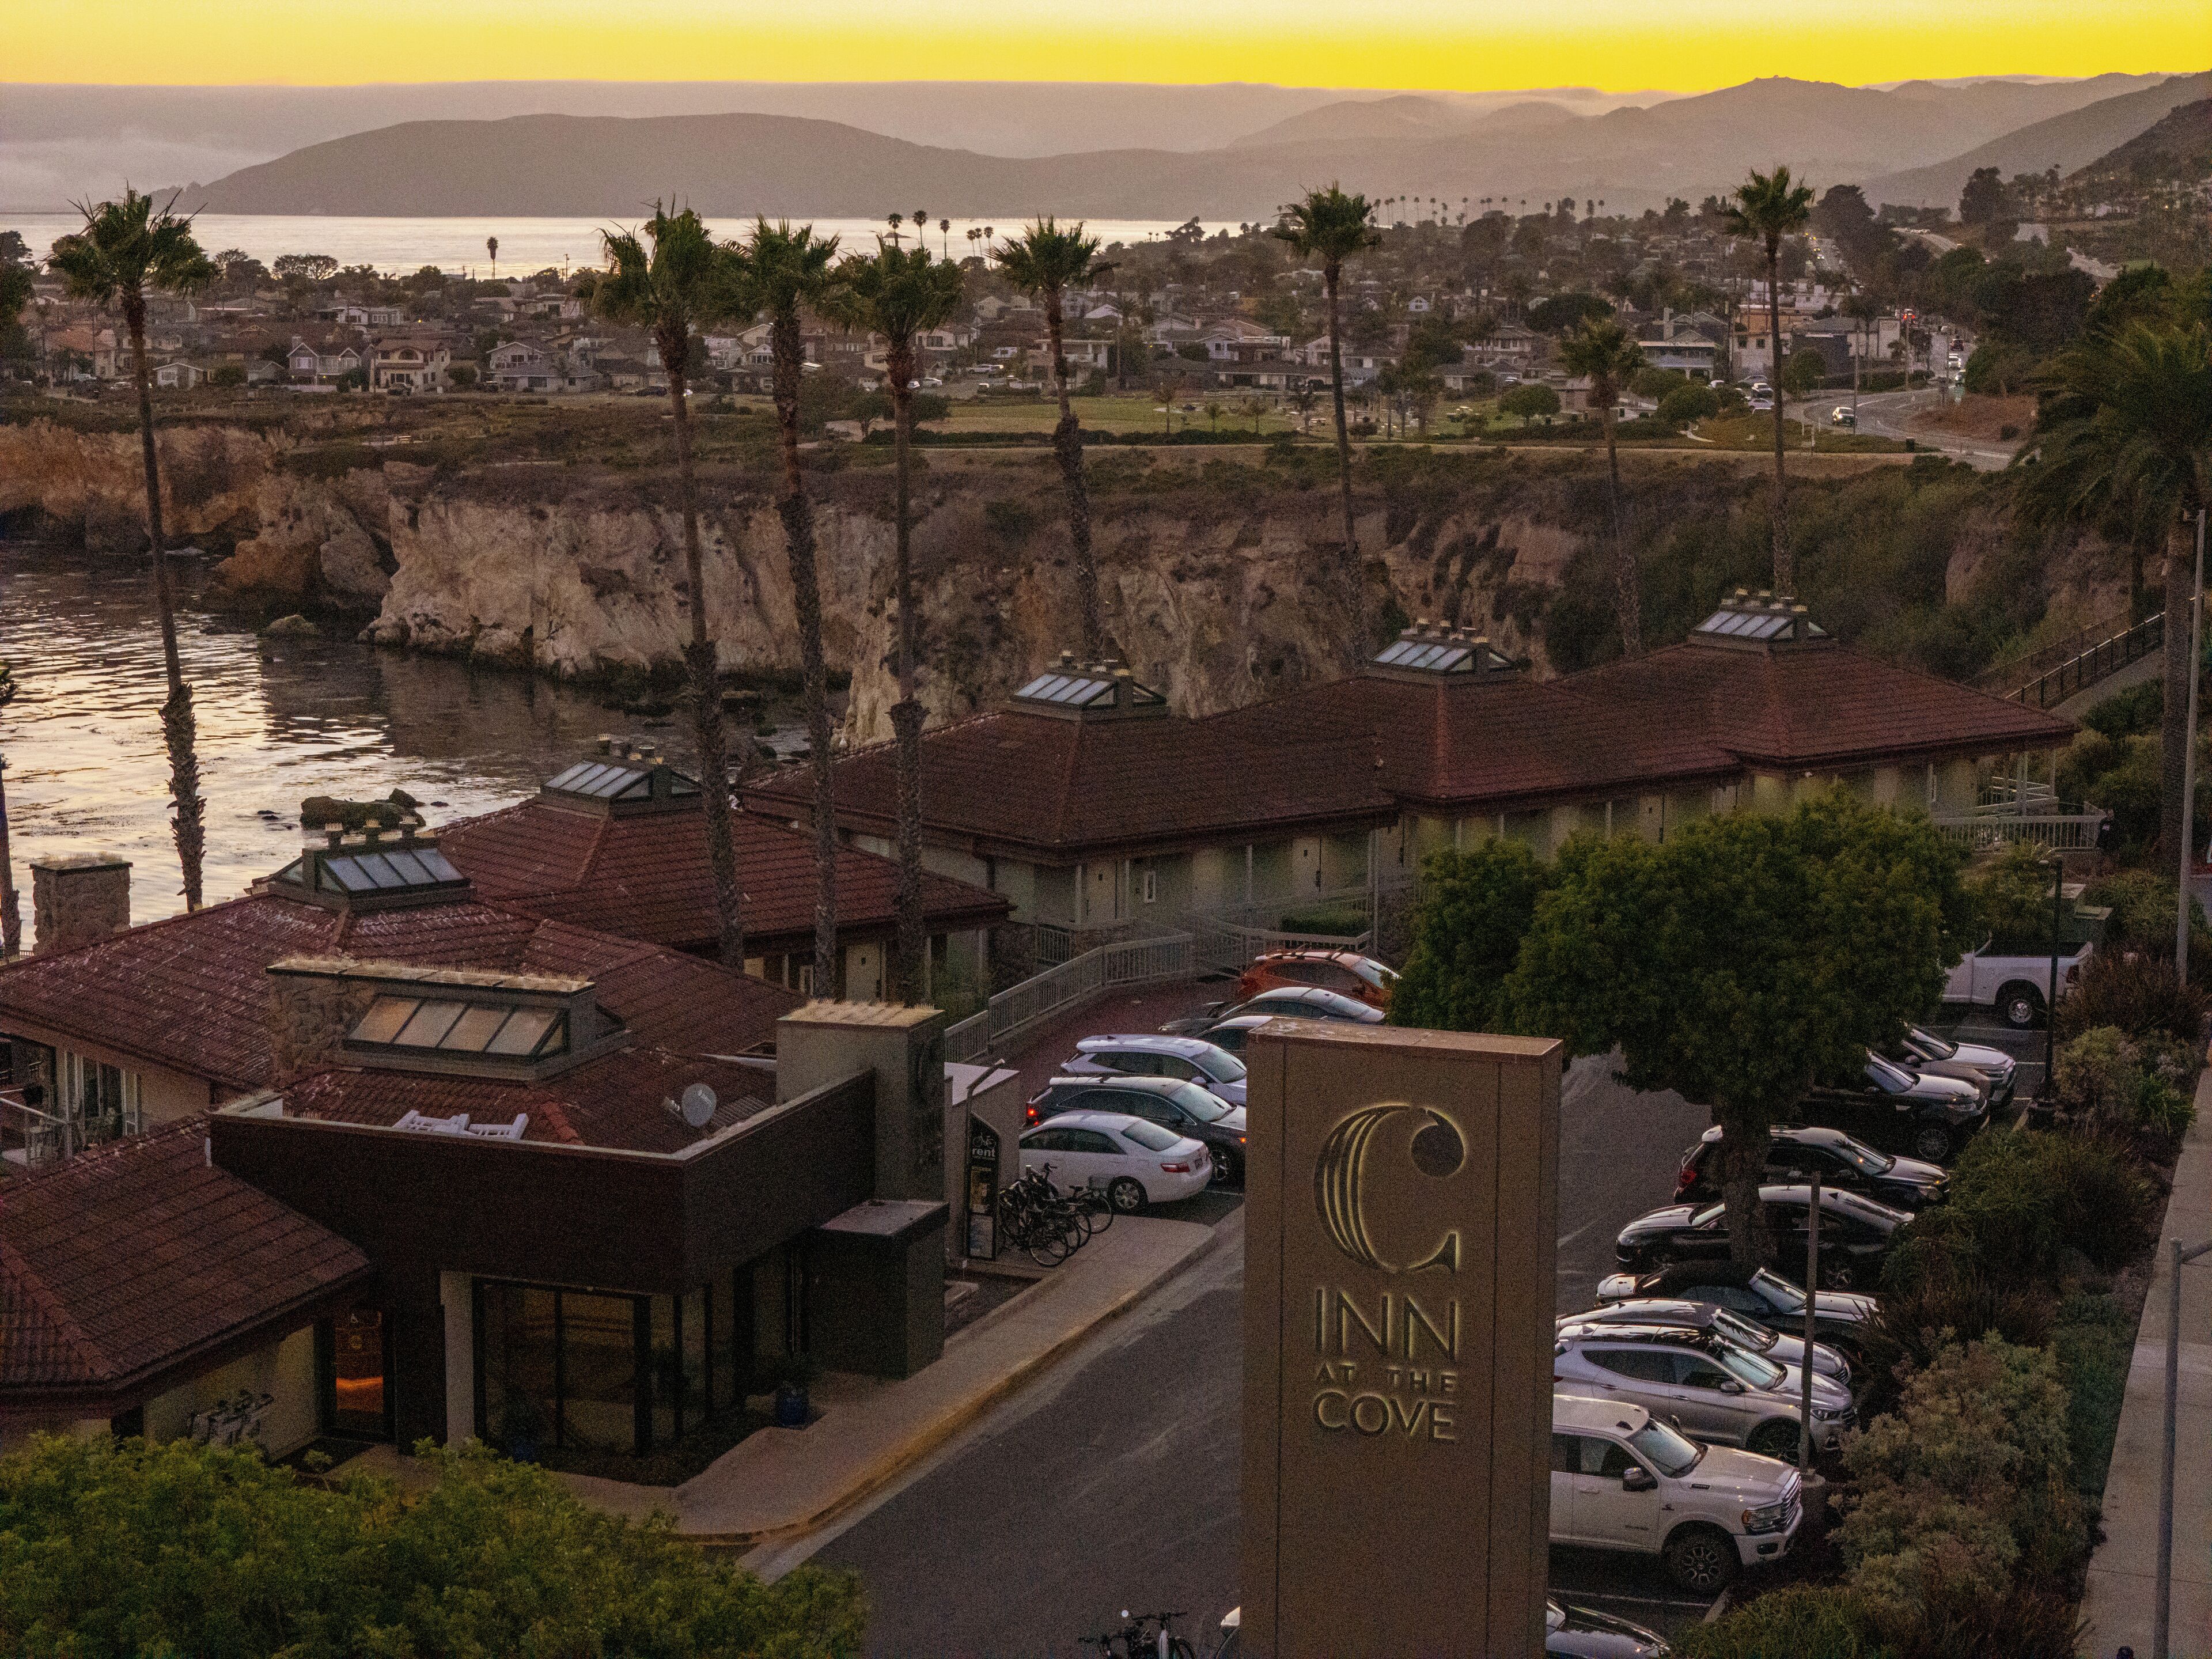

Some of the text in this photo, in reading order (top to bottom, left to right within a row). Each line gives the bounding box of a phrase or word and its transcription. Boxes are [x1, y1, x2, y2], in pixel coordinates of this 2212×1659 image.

[972, 1147, 996, 1157] rent
[1315, 1286, 1459, 1361] INN
[1315, 1361, 1457, 1393] AT THE
[1312, 1389, 1457, 1442] COVE
